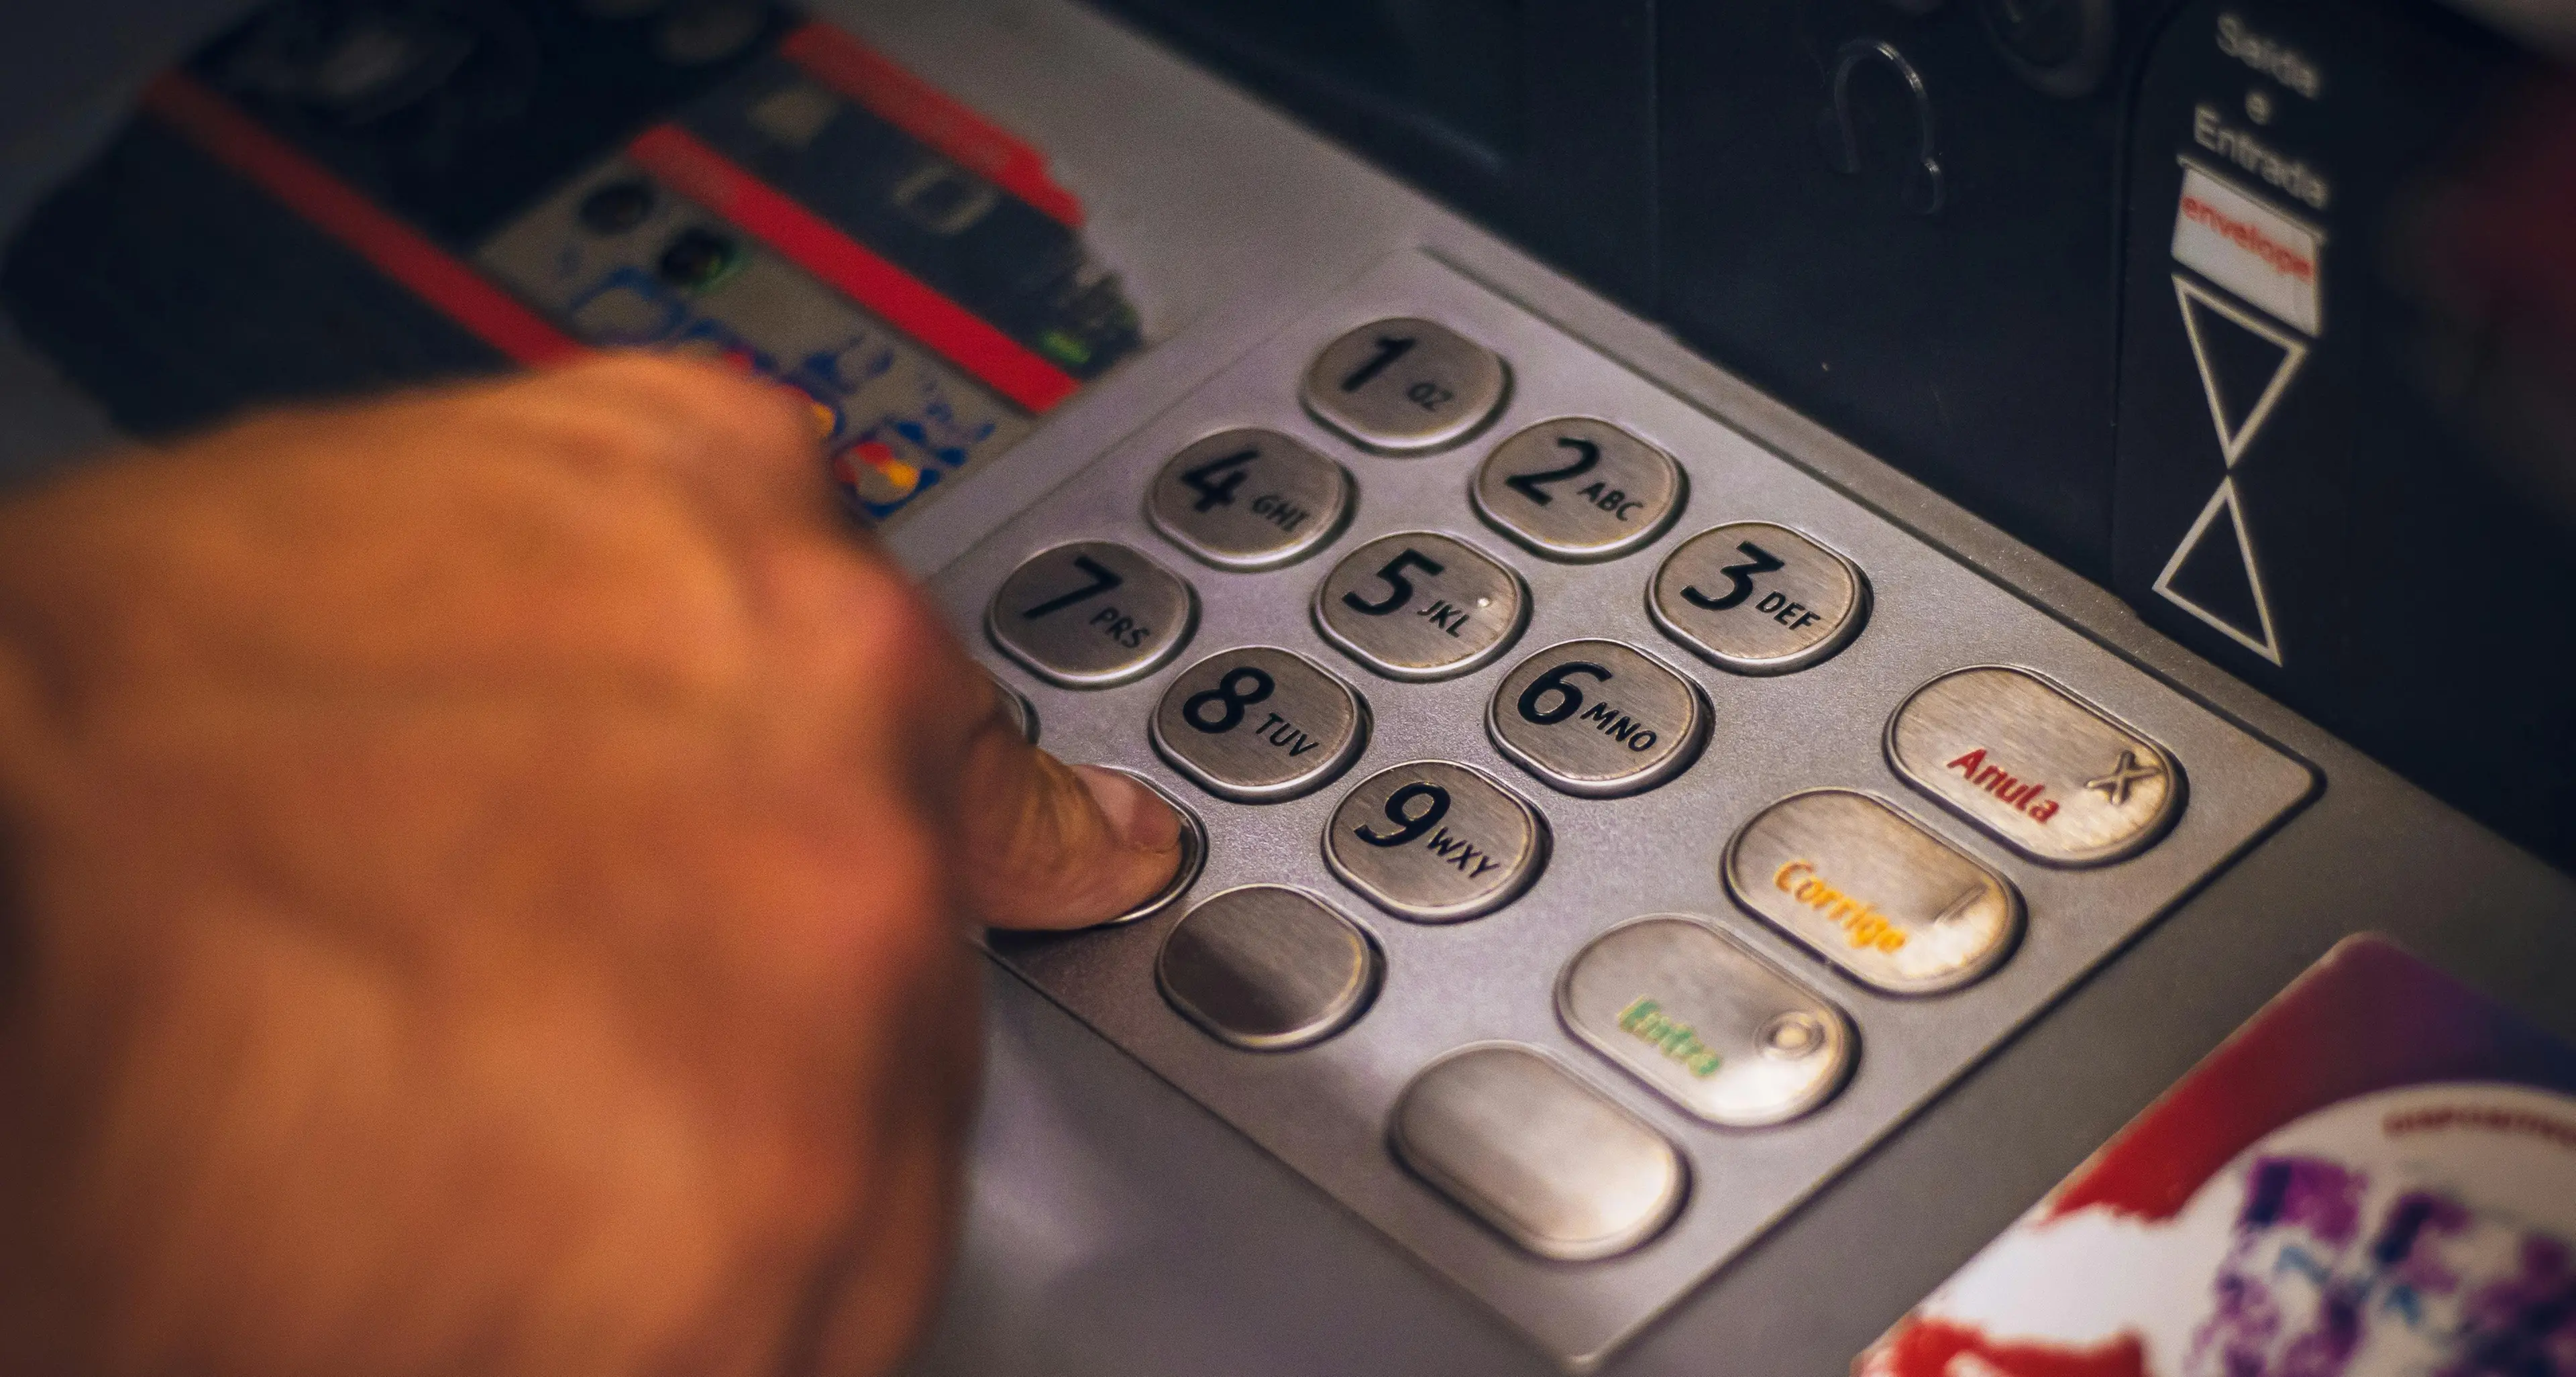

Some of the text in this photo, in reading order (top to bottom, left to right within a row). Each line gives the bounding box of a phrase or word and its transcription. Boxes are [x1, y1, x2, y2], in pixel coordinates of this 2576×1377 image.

[2245, 92, 2271, 125] e
[2194, 104, 2328, 210] Entrada
[2182, 196, 2314, 284] envelope
[1341, 335, 1416, 392] 1
[1180, 448, 1308, 531] 4 GHI
[1505, 437, 1643, 521] 2 ABC
[1022, 555, 1150, 649] 7 PRS
[1342, 548, 1470, 637] 5 JKL
[1680, 541, 1821, 630] 3 DEF
[1183, 666, 1319, 757] 8 TUV
[1517, 661, 1656, 751] 6 MNO
[1354, 781, 1500, 879] 9 WXY
[1947, 748, 2059, 824] Anula
[1773, 859, 1907, 953] Corrige
[1617, 995, 1721, 1078] Entra
